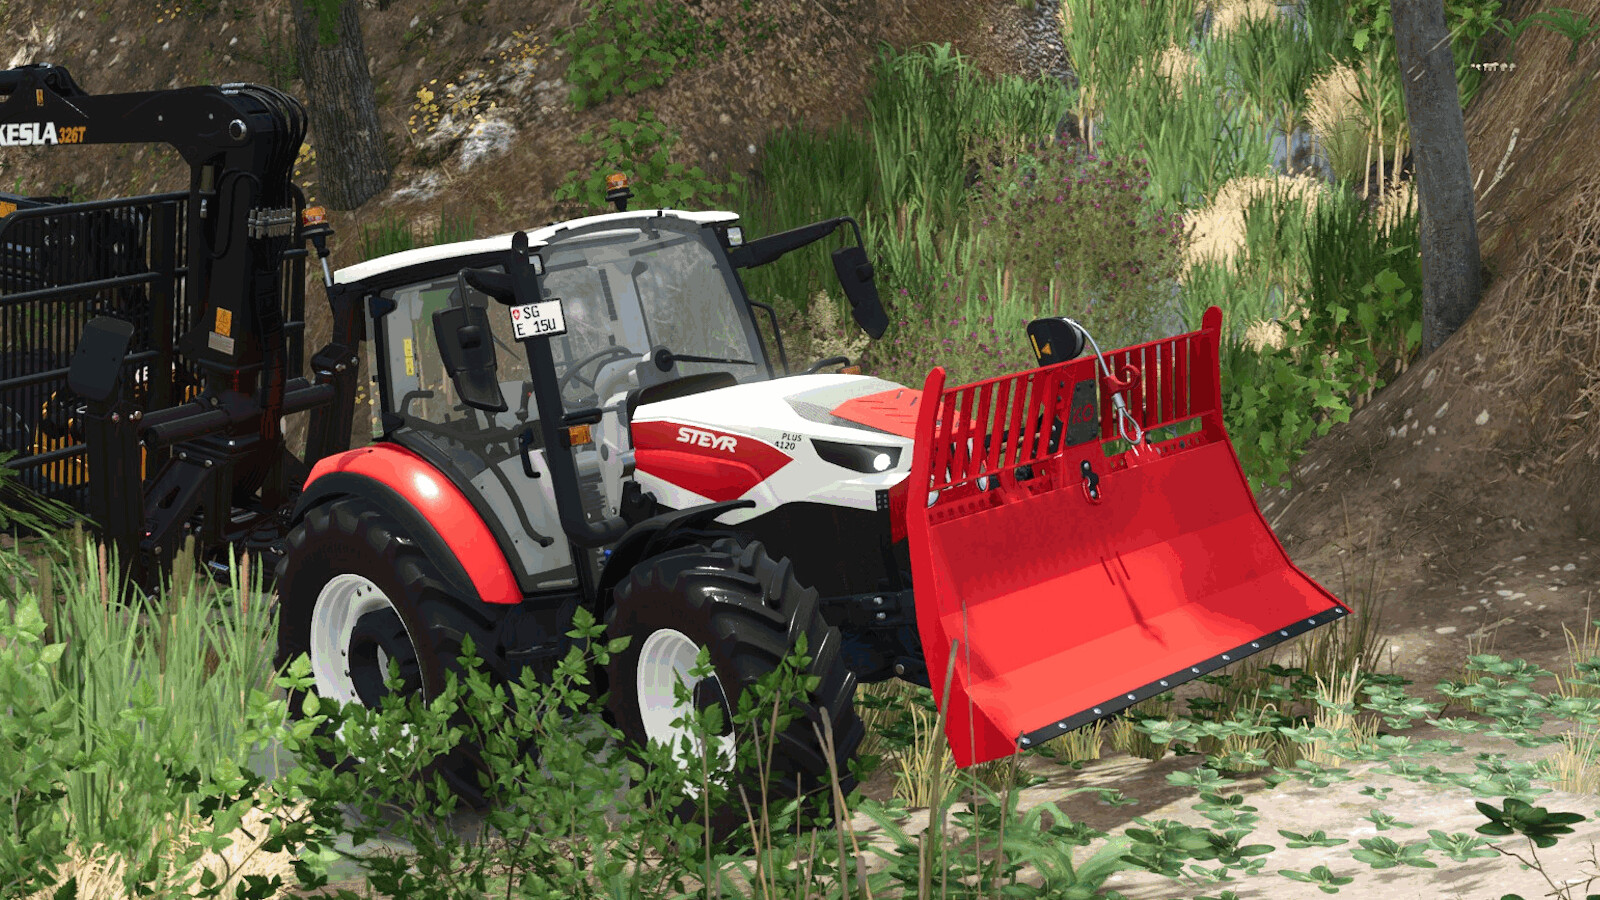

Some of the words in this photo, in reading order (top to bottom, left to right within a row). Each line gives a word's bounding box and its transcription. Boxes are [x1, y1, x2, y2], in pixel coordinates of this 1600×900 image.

[59, 126, 87, 144] 326T
[523, 305, 540, 319] SG
[516, 323, 526, 336] E
[533, 318, 556, 333] 15U
[676, 426, 738, 453] STEYR
[781, 432, 802, 442] PLUS
